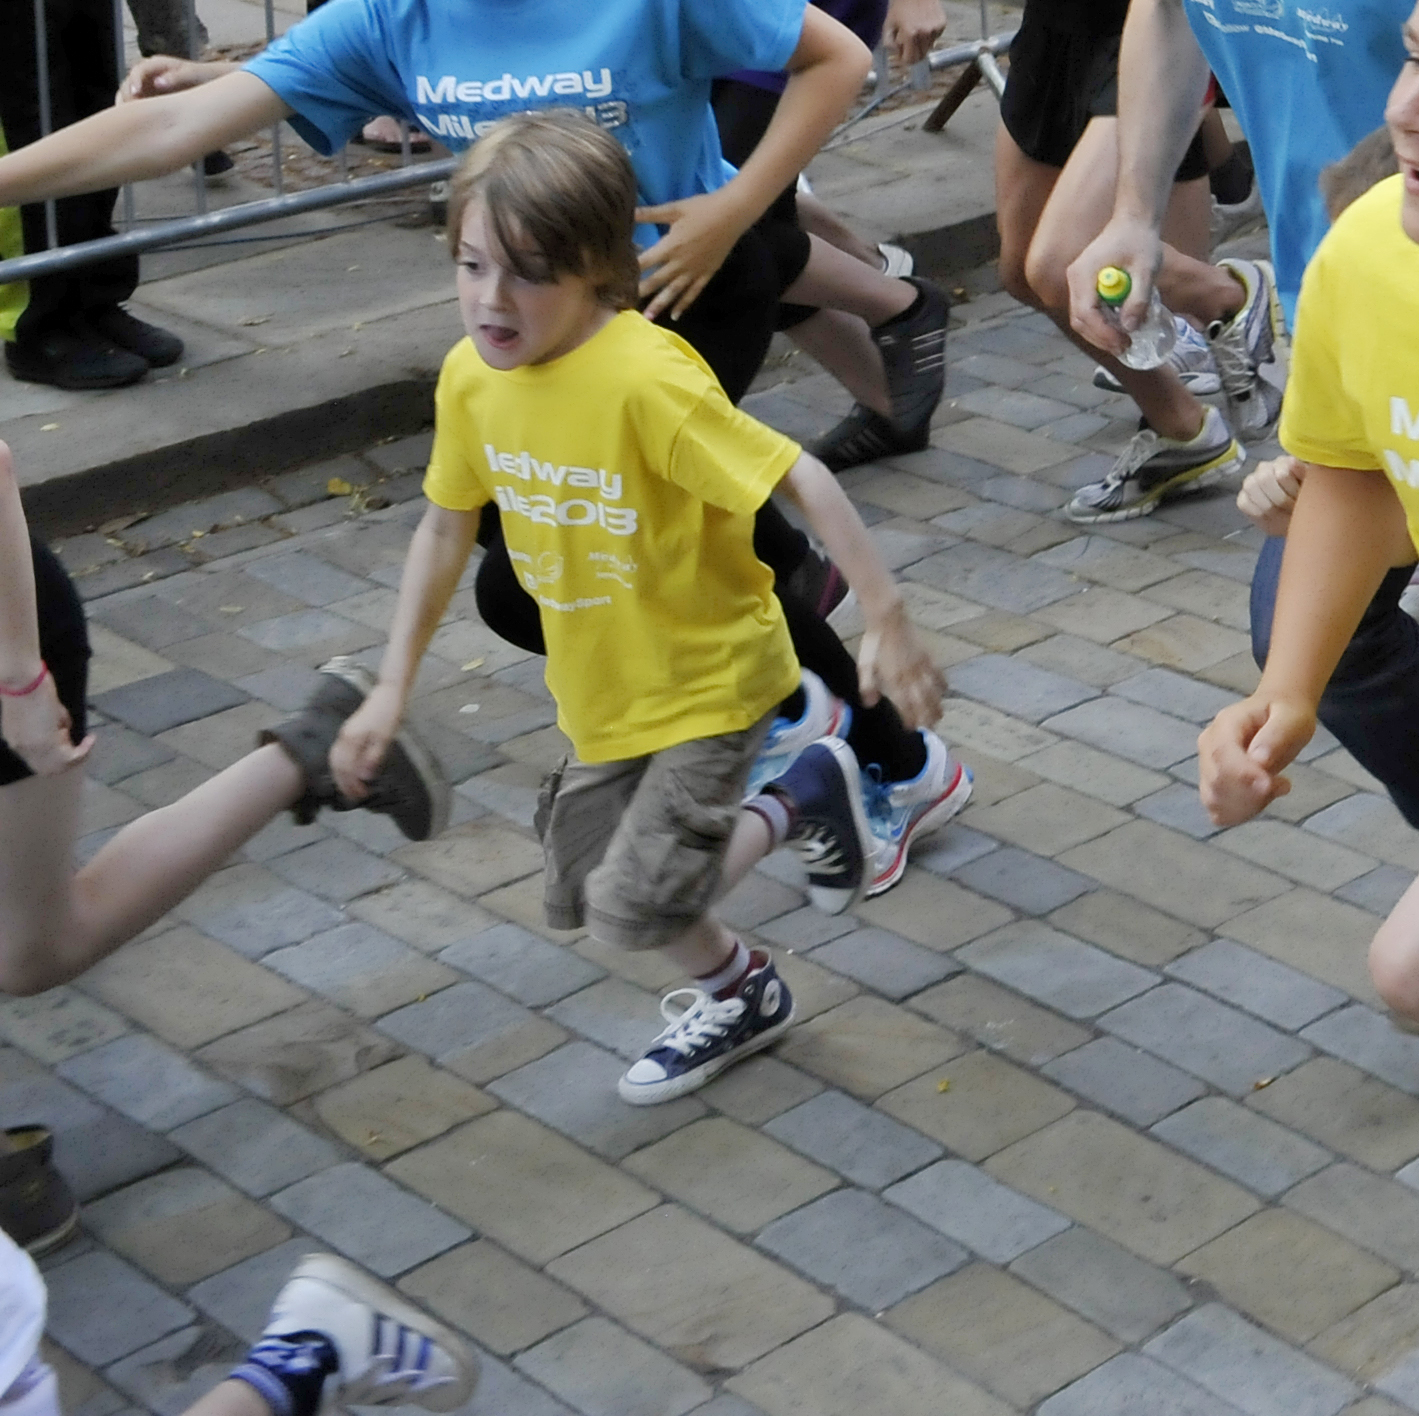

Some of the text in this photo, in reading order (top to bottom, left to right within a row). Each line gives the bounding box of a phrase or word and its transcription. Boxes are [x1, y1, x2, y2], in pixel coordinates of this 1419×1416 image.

[416, 68, 613, 104] Medway
[484, 444, 623, 500] edway
[495, 486, 638, 535] ile 2013
